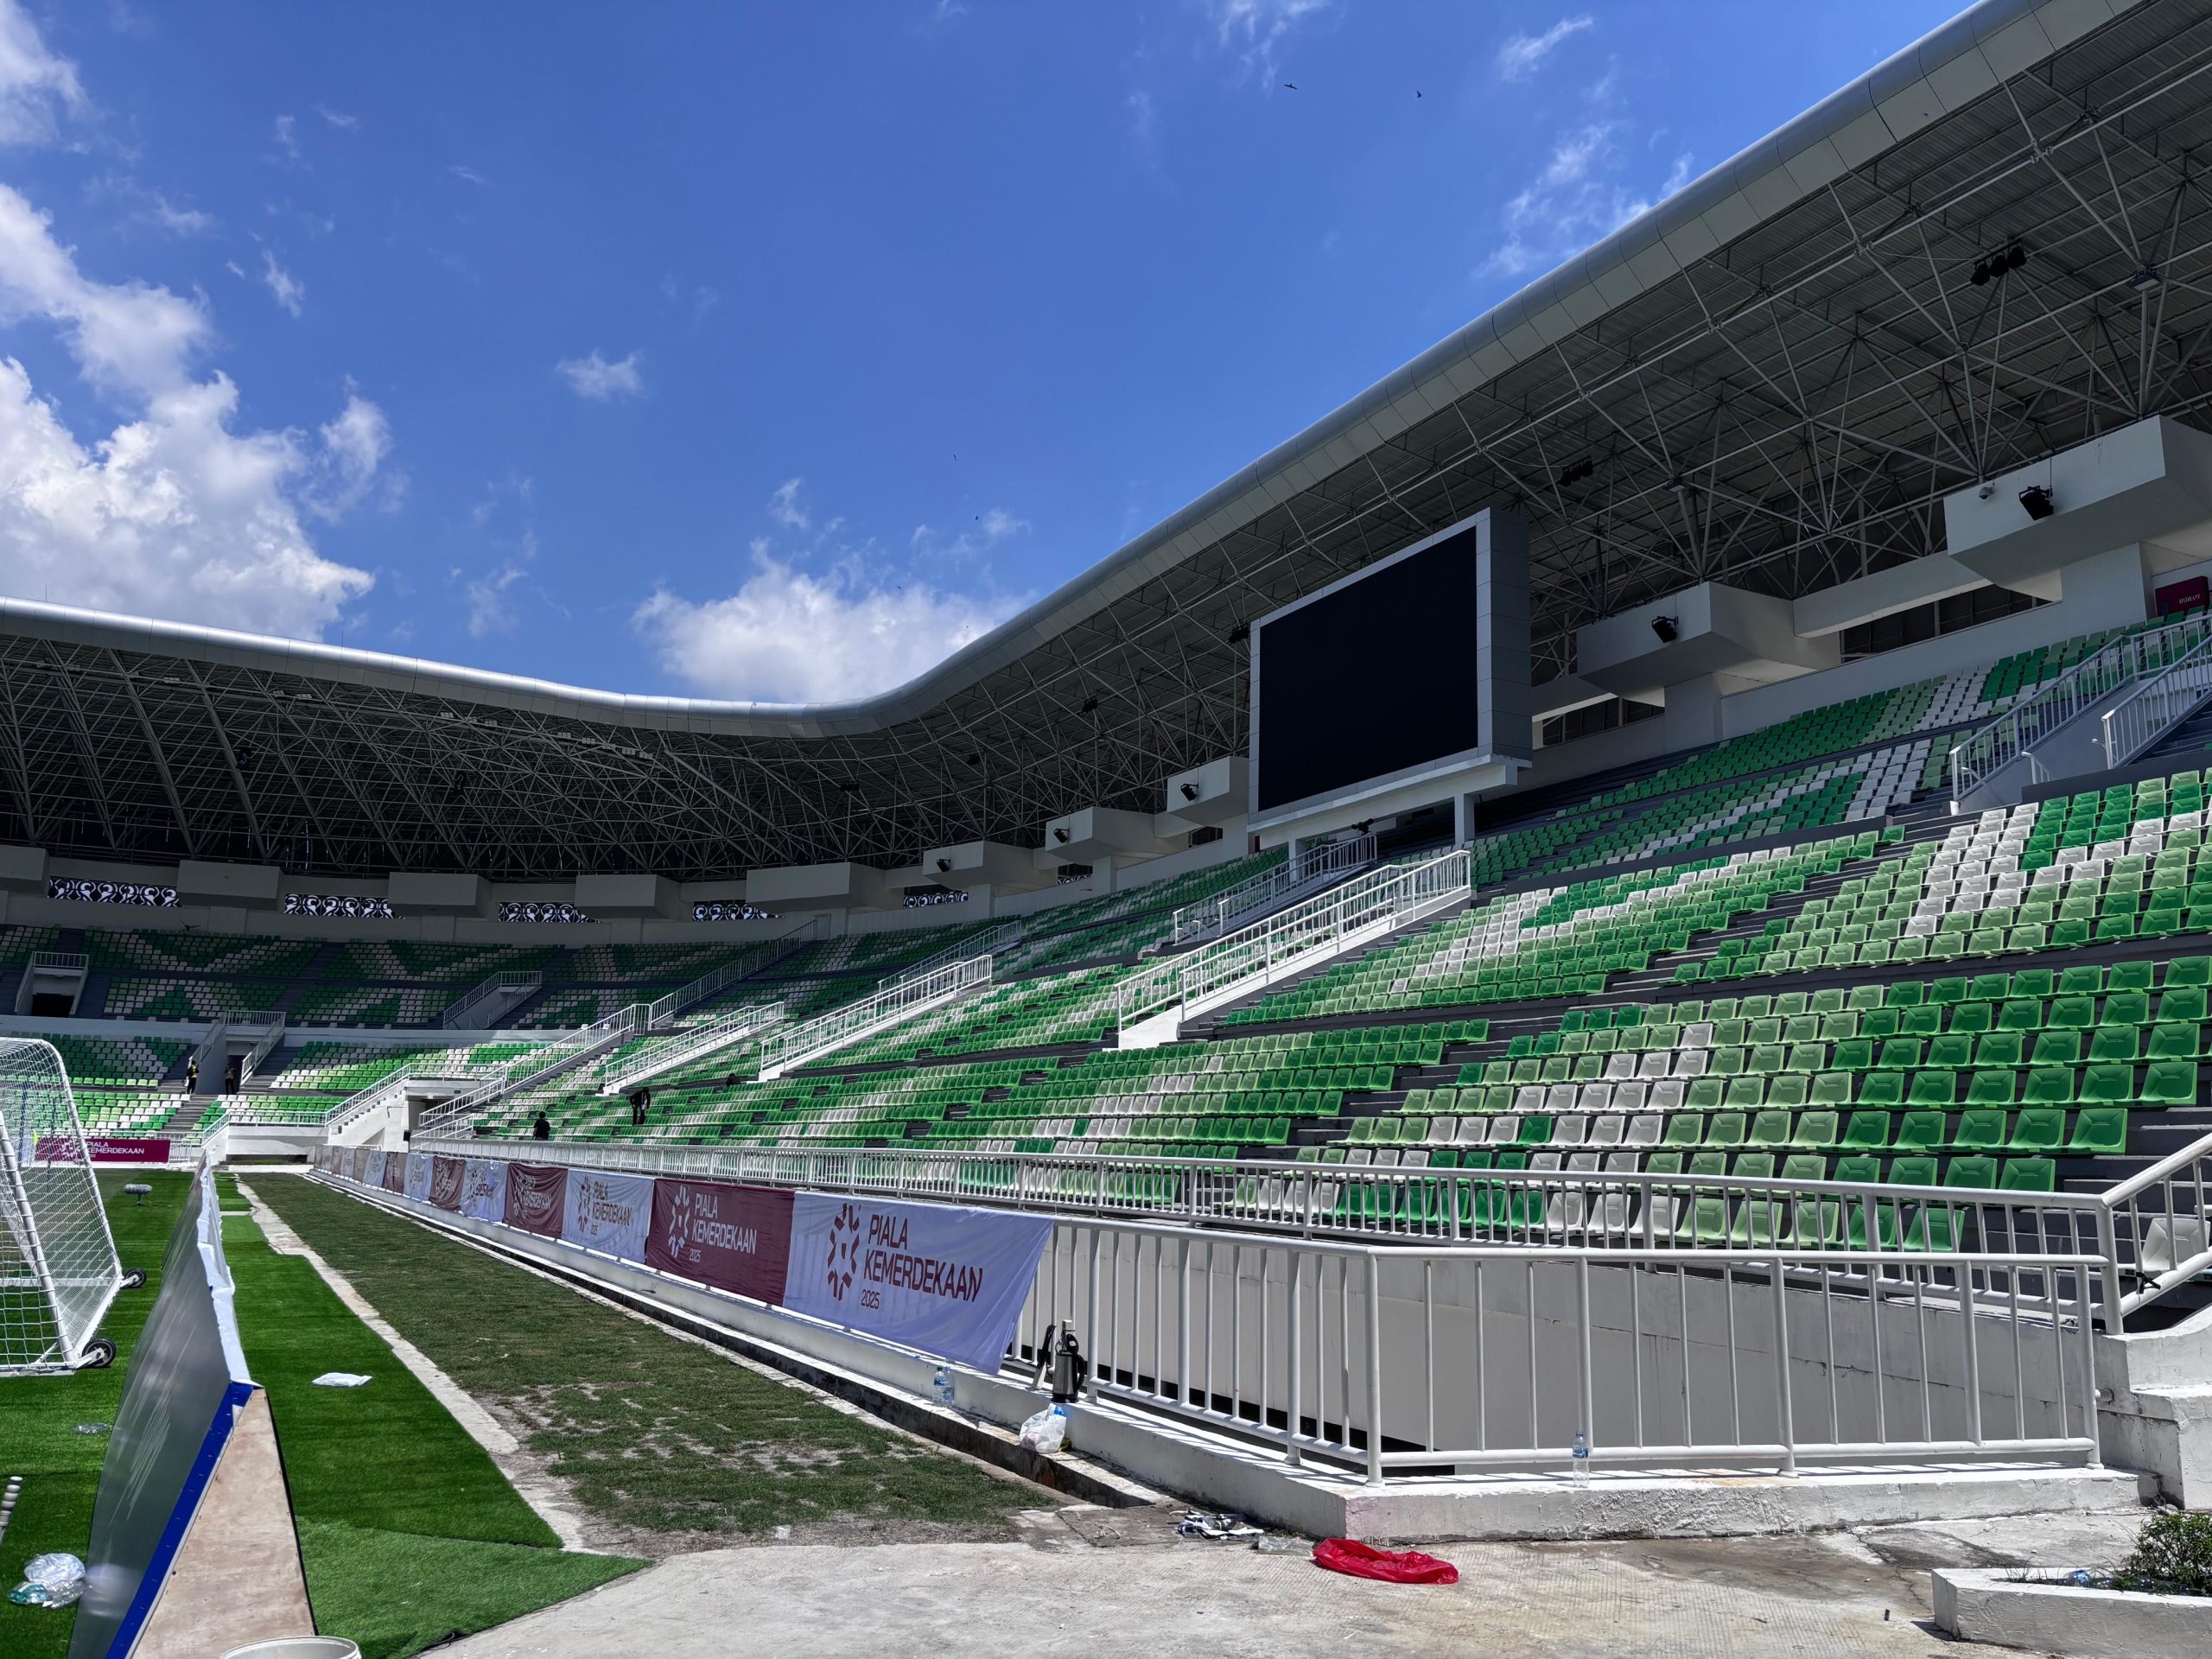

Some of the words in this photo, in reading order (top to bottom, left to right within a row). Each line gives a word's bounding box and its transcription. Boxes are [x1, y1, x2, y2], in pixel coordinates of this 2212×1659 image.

[2179, 594, 2201, 605] HYDRANT
[695, 1192, 718, 1219] PIALA
[691, 1219, 757, 1255] KEMERDEKAAN
[868, 1214, 908, 1250] PIALA
[689, 1248, 702, 1263] 2025
[863, 1249, 983, 1302] KEMERDEKAAN
[861, 1288, 880, 1310] 2025
